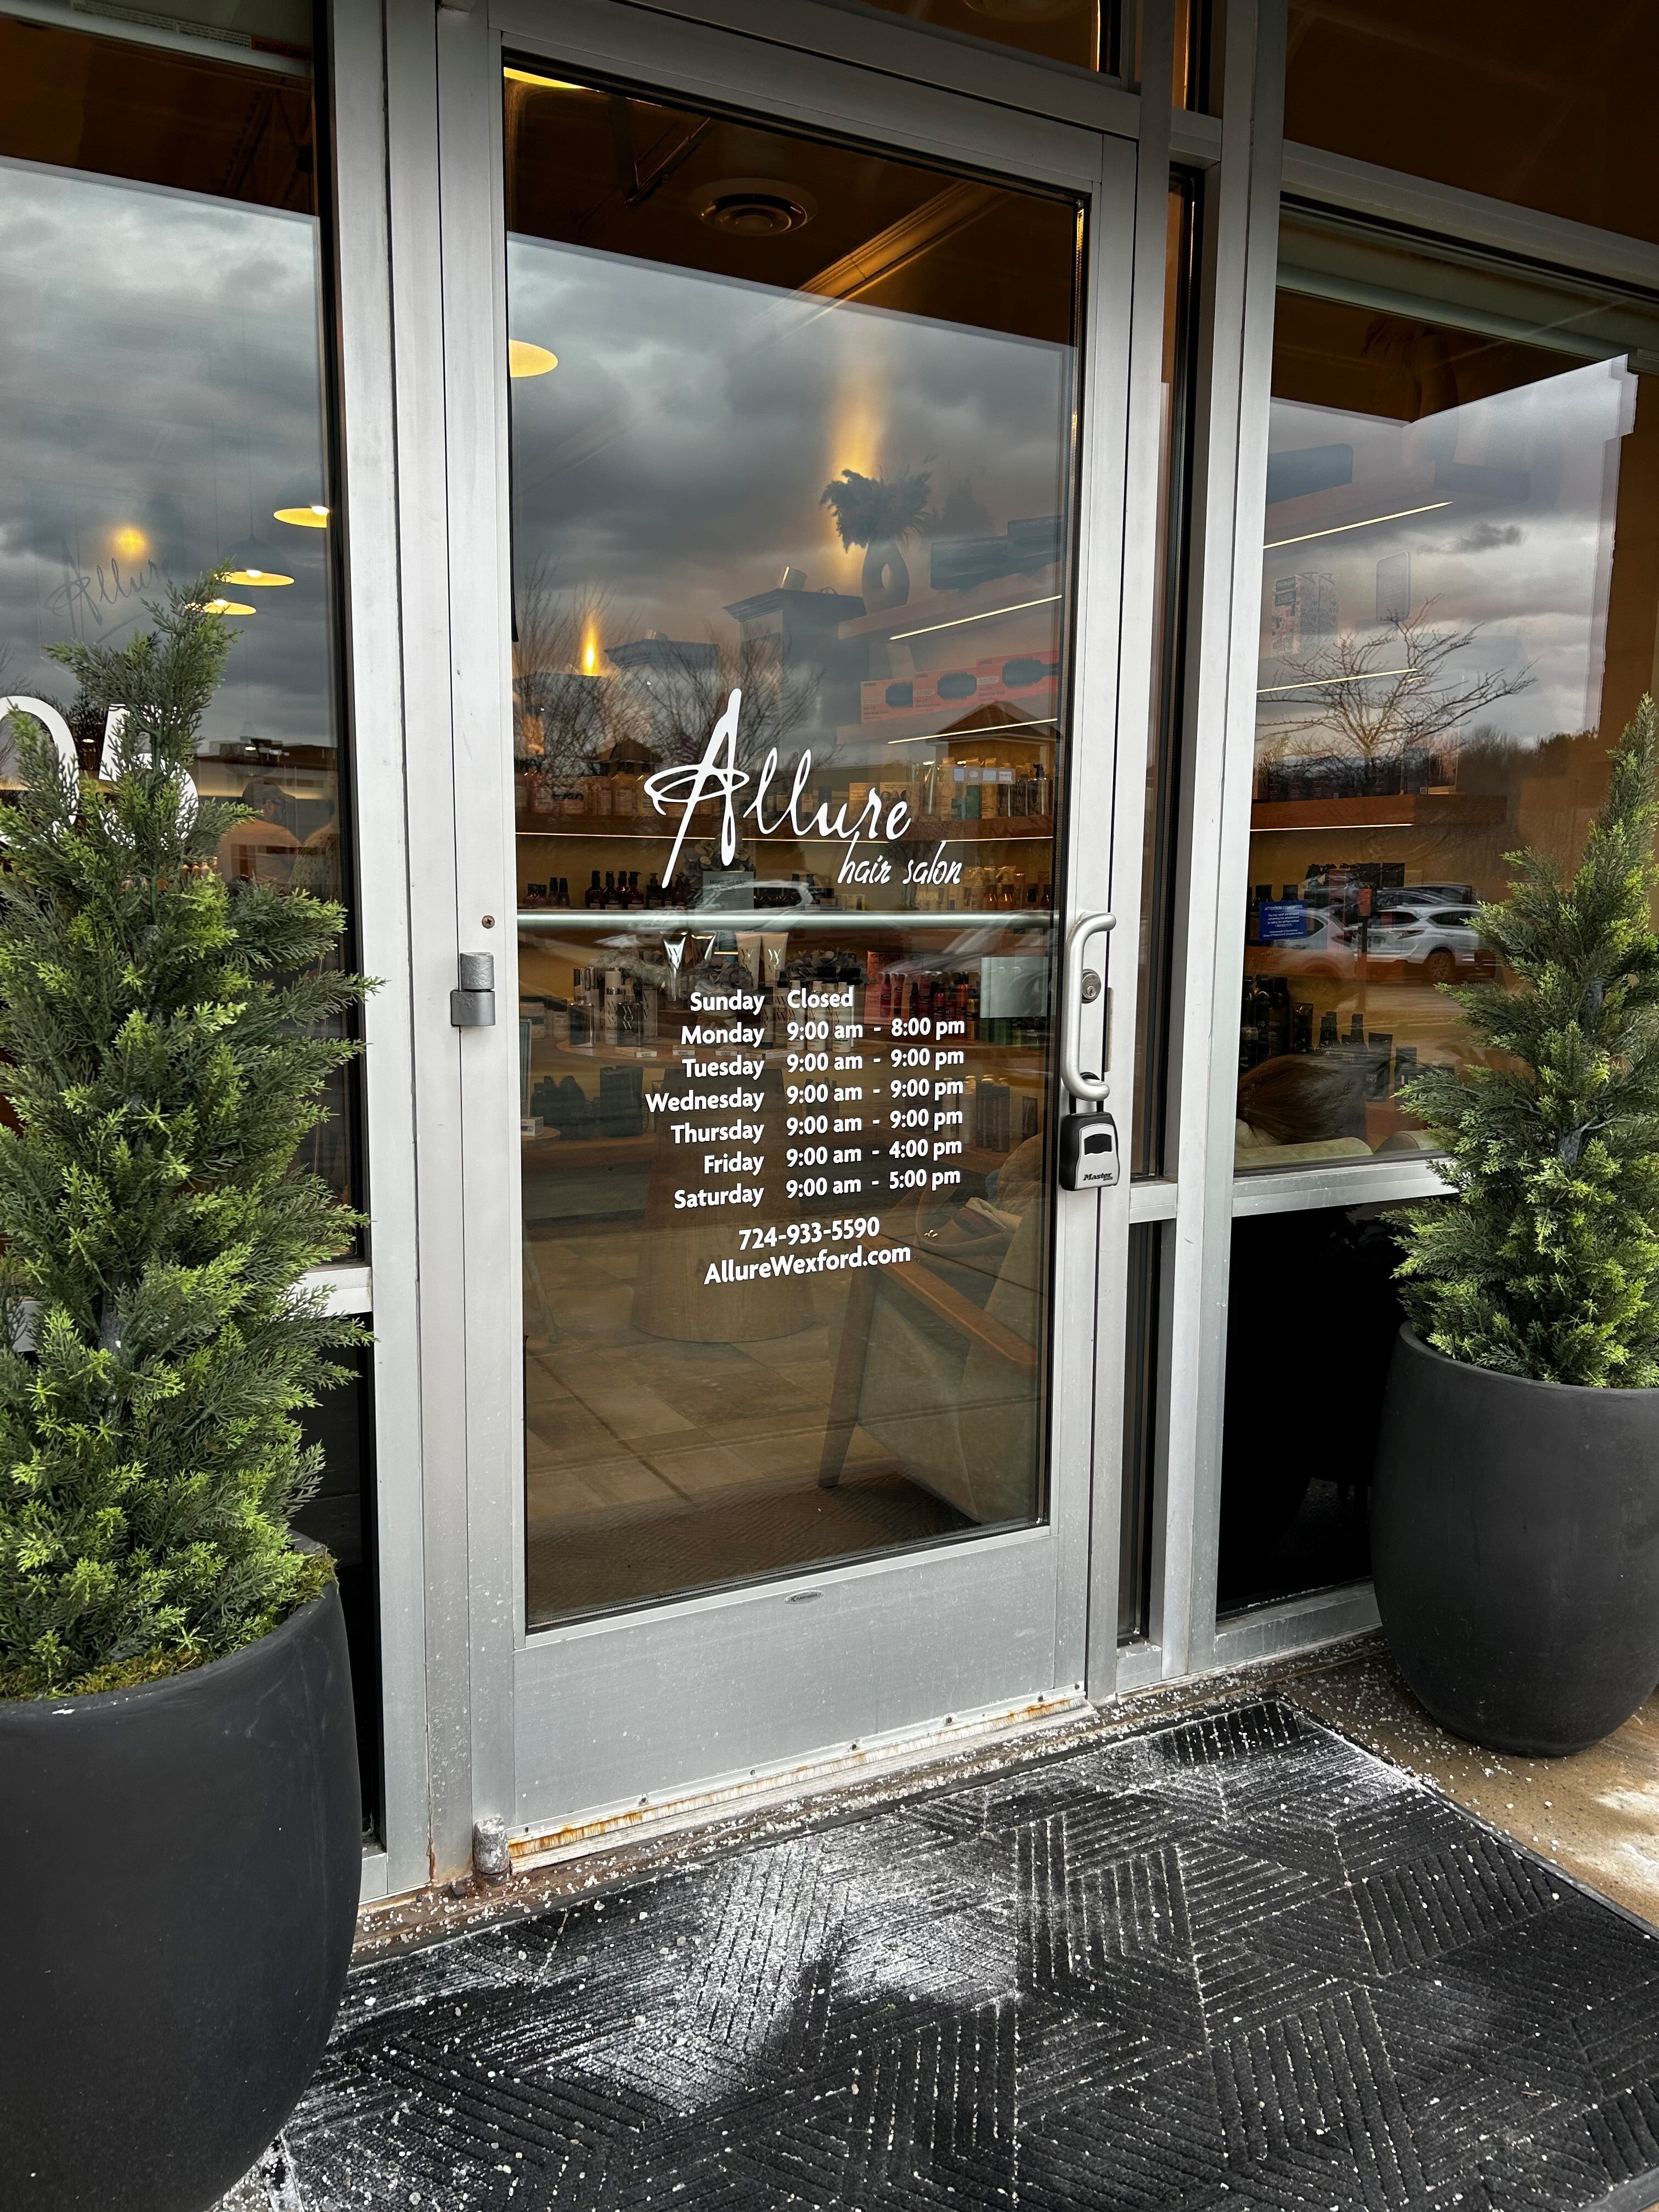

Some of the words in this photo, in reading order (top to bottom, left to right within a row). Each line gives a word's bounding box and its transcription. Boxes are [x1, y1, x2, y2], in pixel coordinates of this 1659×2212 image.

[644, 688, 911, 888] Allure
[837, 831, 891, 884] hair
[902, 841, 962, 885] salon
[690, 989, 765, 1015] Sunday
[787, 986, 854, 1009] Closed
[681, 1022, 765, 1048] Monday
[787, 1020, 829, 1041] 9:00
[834, 1024, 863, 1039] am
[891, 1017, 931, 1037] 8:00
[935, 1020, 964, 1041] pm
[681, 1054, 765, 1080] Tuesday
[787, 1052, 828, 1073] 9:00
[834, 1056, 862, 1070] am
[890, 1048, 930, 1068] 9:00
[935, 1051, 964, 1071] pm
[645, 1087, 765, 1113] Wednesday
[786, 1084, 828, 1104] 9:00
[833, 1087, 862, 1102] am
[890, 1078, 929, 1098] 9:00
[934, 1081, 963, 1101] pm
[670, 1119, 765, 1144] Thursday
[786, 1115, 828, 1136] 9:00
[833, 1118, 862, 1133] am
[890, 1108, 929, 1129] 9:00
[934, 1111, 963, 1131] pm
[704, 1151, 764, 1176] Friday
[786, 1146, 828, 1167] 9:00
[833, 1148, 861, 1164] am
[889, 1138, 928, 1159] 4:00
[933, 1141, 962, 1161] pm
[674, 1183, 764, 1209] Saturday
[786, 1177, 827, 1199] 9:00
[832, 1179, 861, 1194] am
[889, 1169, 927, 1189] 5:00
[932, 1170, 961, 1191] pm
[738, 1216, 880, 1250] 724-933-5590
[703, 1245, 911, 1285] AllureWexford.com
